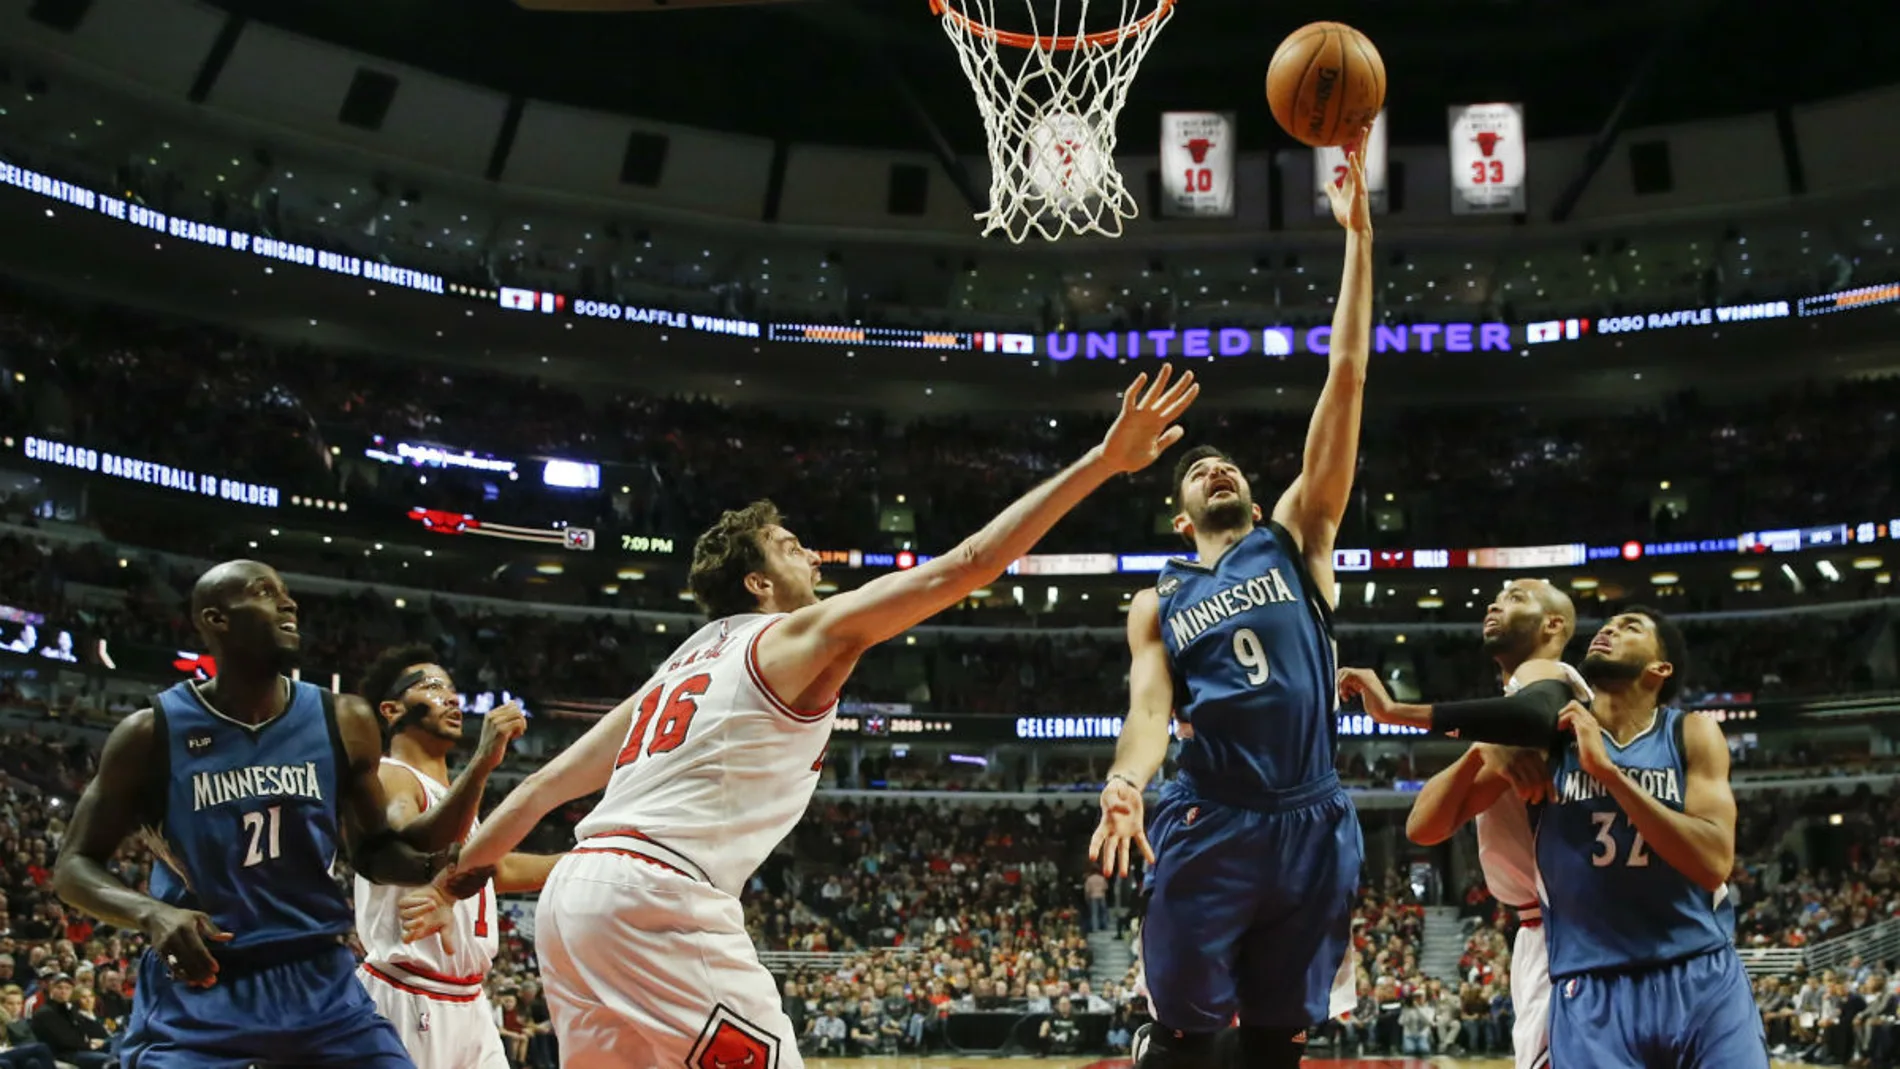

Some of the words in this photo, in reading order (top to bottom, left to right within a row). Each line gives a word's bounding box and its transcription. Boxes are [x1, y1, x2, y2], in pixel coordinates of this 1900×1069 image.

[1184, 168, 1213, 193] 10
[1471, 160, 1504, 184] 33
[0, 161, 95, 210] CELEBRATING
[99, 194, 126, 220] THE
[129, 204, 166, 233] 50TH
[169, 216, 227, 247] SEASON
[231, 230, 249, 251] OF
[253, 235, 315, 266] CHICAGO
[318, 250, 360, 276] BULLS
[364, 260, 444, 294] BASKETBALL
[574, 299, 621, 319] 5050
[625, 306, 687, 328] RAFFLE
[691, 314, 760, 338] WINNER
[1597, 315, 1644, 334] 5050
[1648, 308, 1712, 329] RAFFLE
[1716, 301, 1790, 323] WINNER
[1047, 328, 1251, 360] UNITED
[1306, 322, 1512, 355] CNTER
[25, 436, 97, 471] CHICAGO
[102, 453, 197, 492] BASKETBALL
[201, 473, 217, 497] IS
[220, 478, 279, 508] GOLDEN
[621, 534, 650, 551] 7:09
[650, 537, 673, 553] PM
[1168, 567, 1297, 651] MINNESOTA
[1232, 627, 1270, 686] 9
[615, 672, 713, 770] 16
[1015, 717, 1123, 738] CELEBRATING
[193, 761, 323, 812] MINNESOTA
[242, 805, 283, 868] 21
